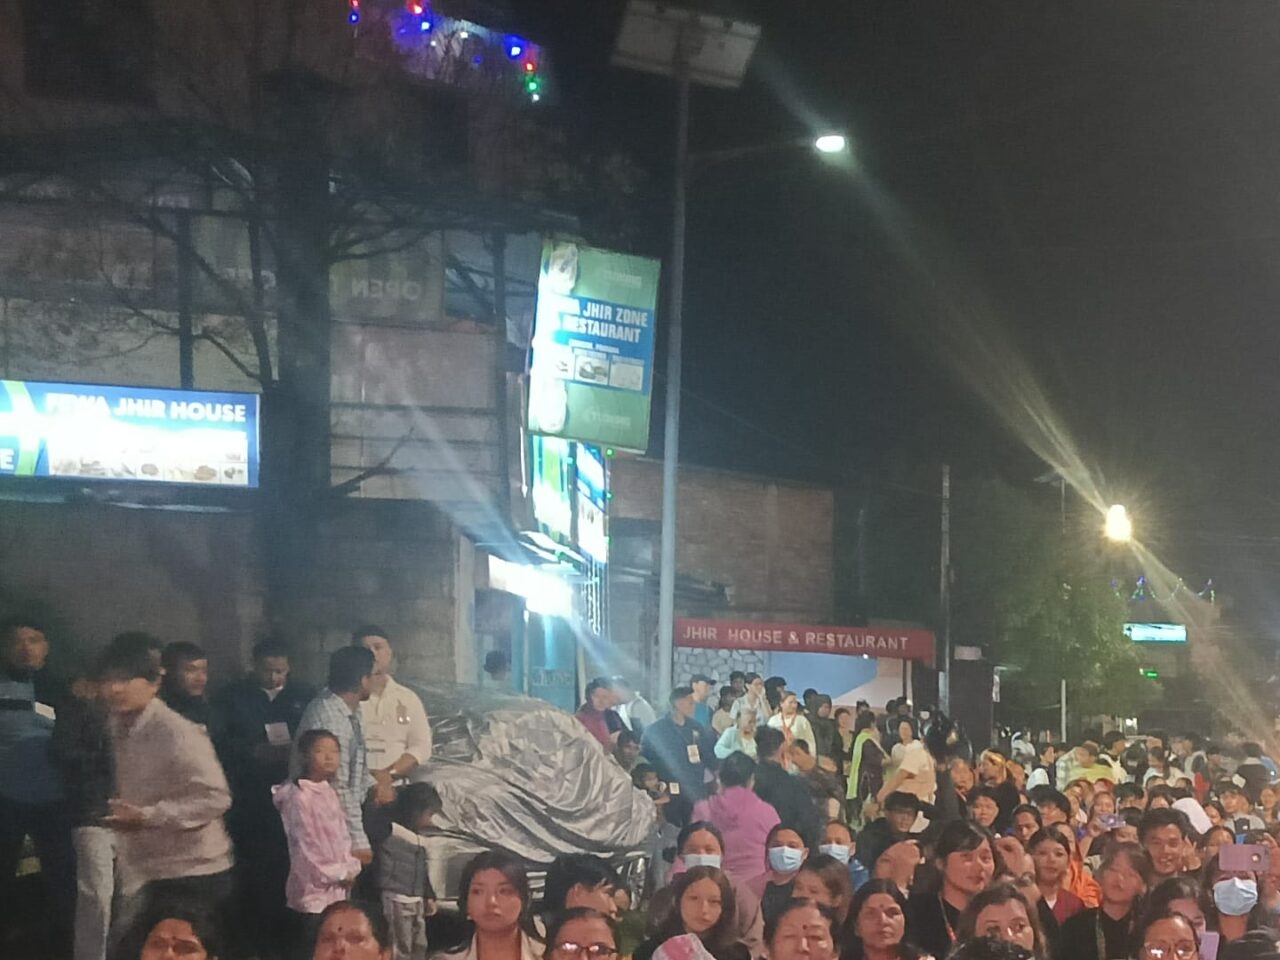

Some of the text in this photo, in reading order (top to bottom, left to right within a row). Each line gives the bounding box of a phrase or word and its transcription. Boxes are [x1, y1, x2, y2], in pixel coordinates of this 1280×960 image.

[583, 302, 612, 320] JHIR
[616, 308, 648, 326] ZONE
[114, 397, 166, 418] JHIR
[170, 401, 247, 423] HOUSE
[682, 625, 909, 651] JHIR HOUSE & RESTAURANT
